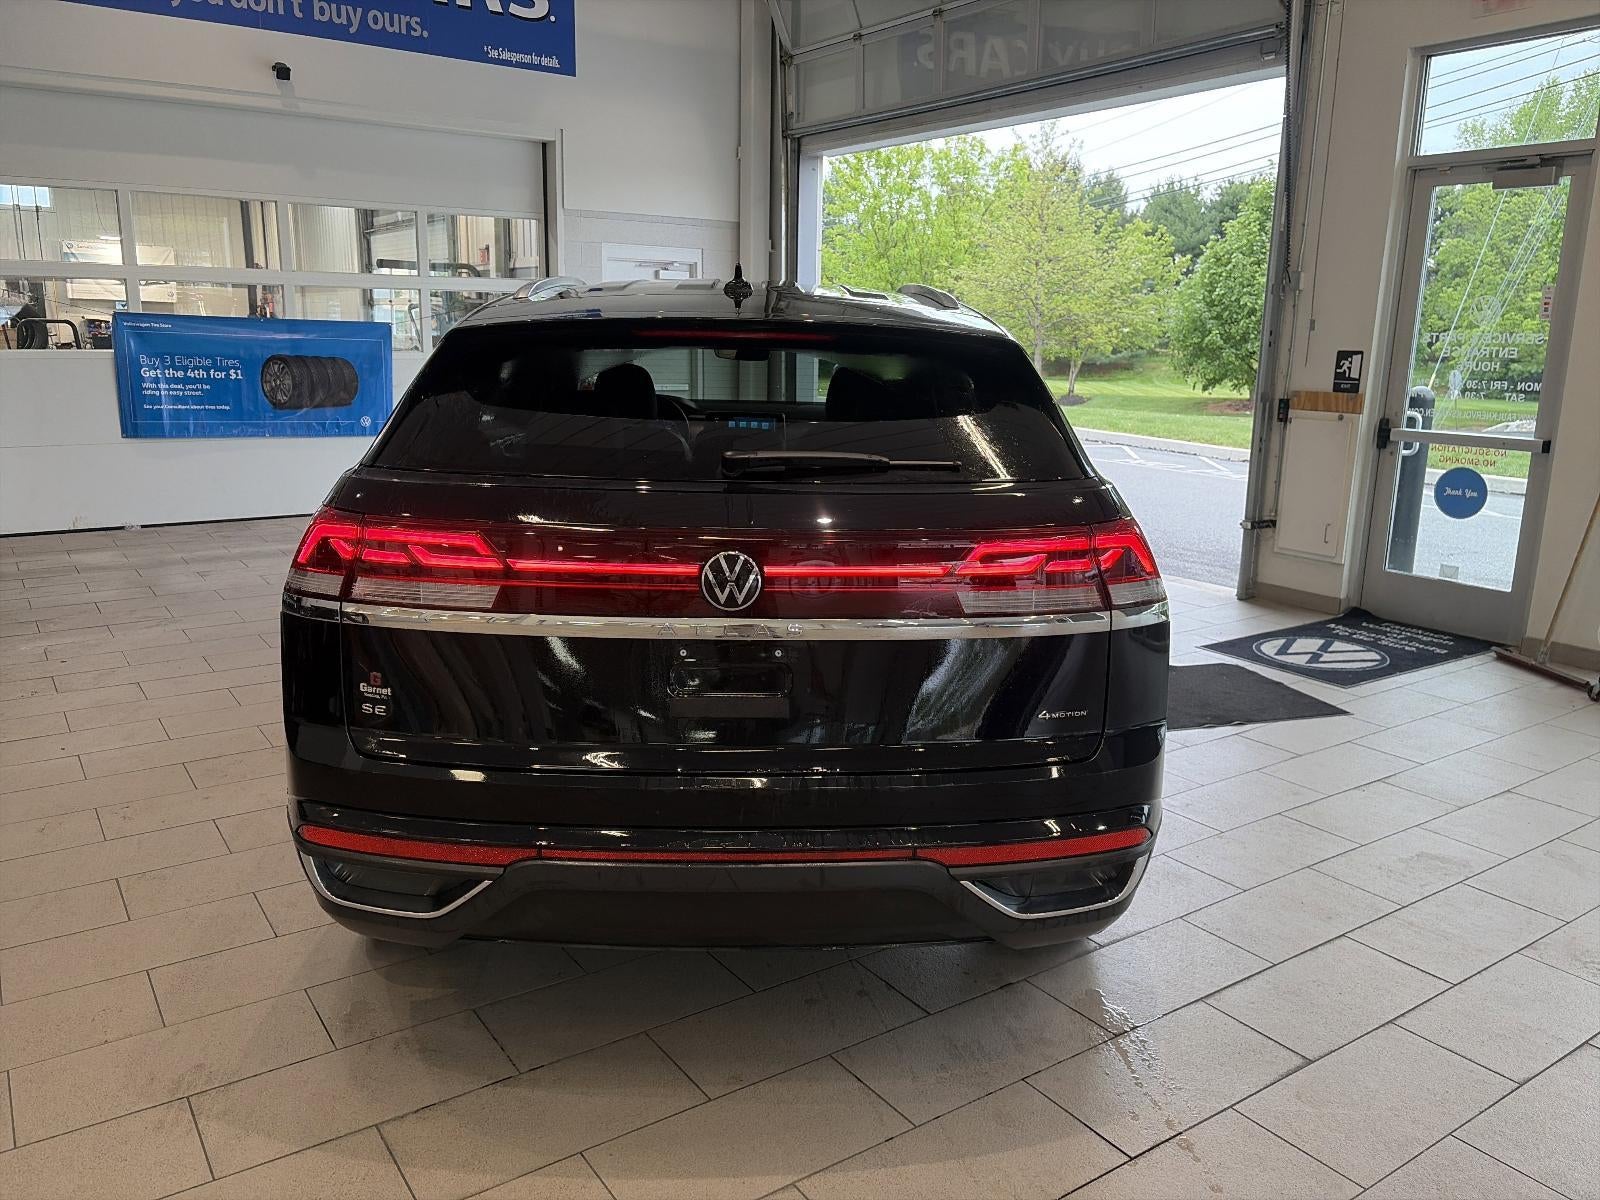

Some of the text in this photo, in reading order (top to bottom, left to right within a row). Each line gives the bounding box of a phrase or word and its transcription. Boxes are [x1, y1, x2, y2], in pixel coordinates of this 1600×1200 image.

[313, 0, 362, 33] buy
[367, 9, 429, 38] ours.
[488, 46, 561, 68] See Salesperson for details.
[140, 354, 242, 368] Buy 3 Eligible Tires,
[140, 368, 243, 380] Get the 4th for $1
[657, 622, 803, 638] ATLAS
[359, 682, 392, 696] Garnet
[361, 703, 387, 716] SE
